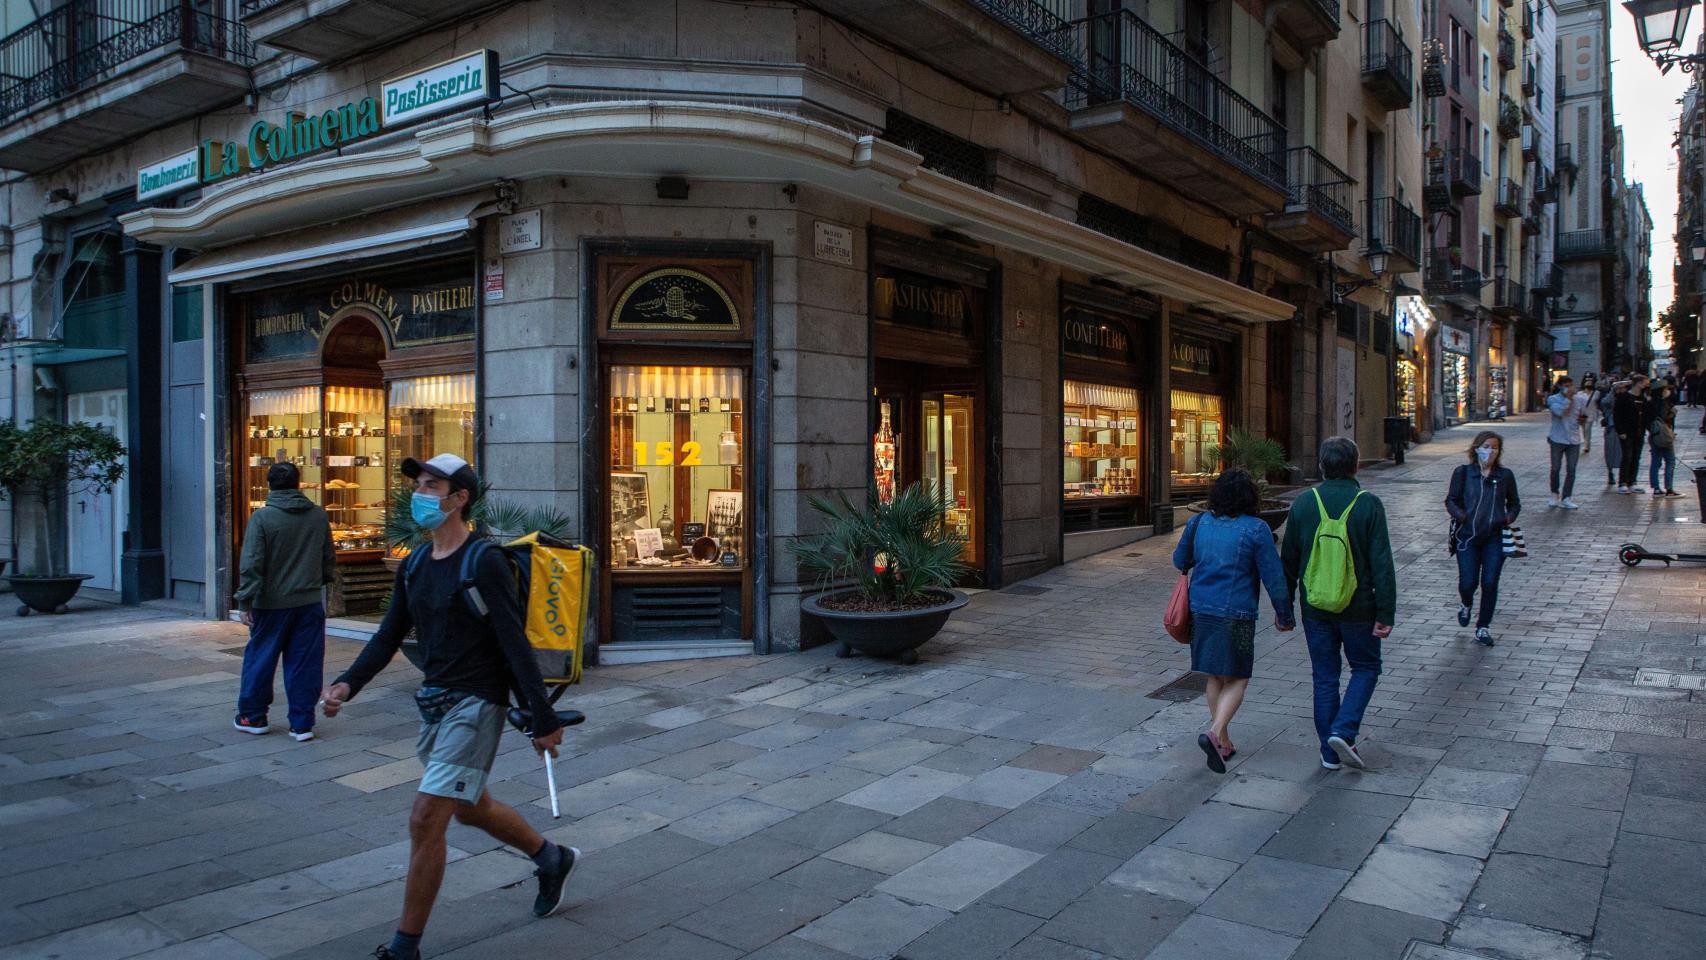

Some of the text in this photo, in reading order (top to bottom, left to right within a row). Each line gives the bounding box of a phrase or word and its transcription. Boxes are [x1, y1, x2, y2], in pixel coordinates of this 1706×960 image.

[386, 65, 483, 117] Pastisseria
[203, 96, 380, 182] La Colmena
[140, 158, 197, 194] Bomboneria
[330, 281, 404, 336] COLMENA
[885, 279, 965, 321] PASTISSERIA
[255, 312, 306, 338] BOMBONERIA
[1064, 319, 1129, 353] CONFITERIA
